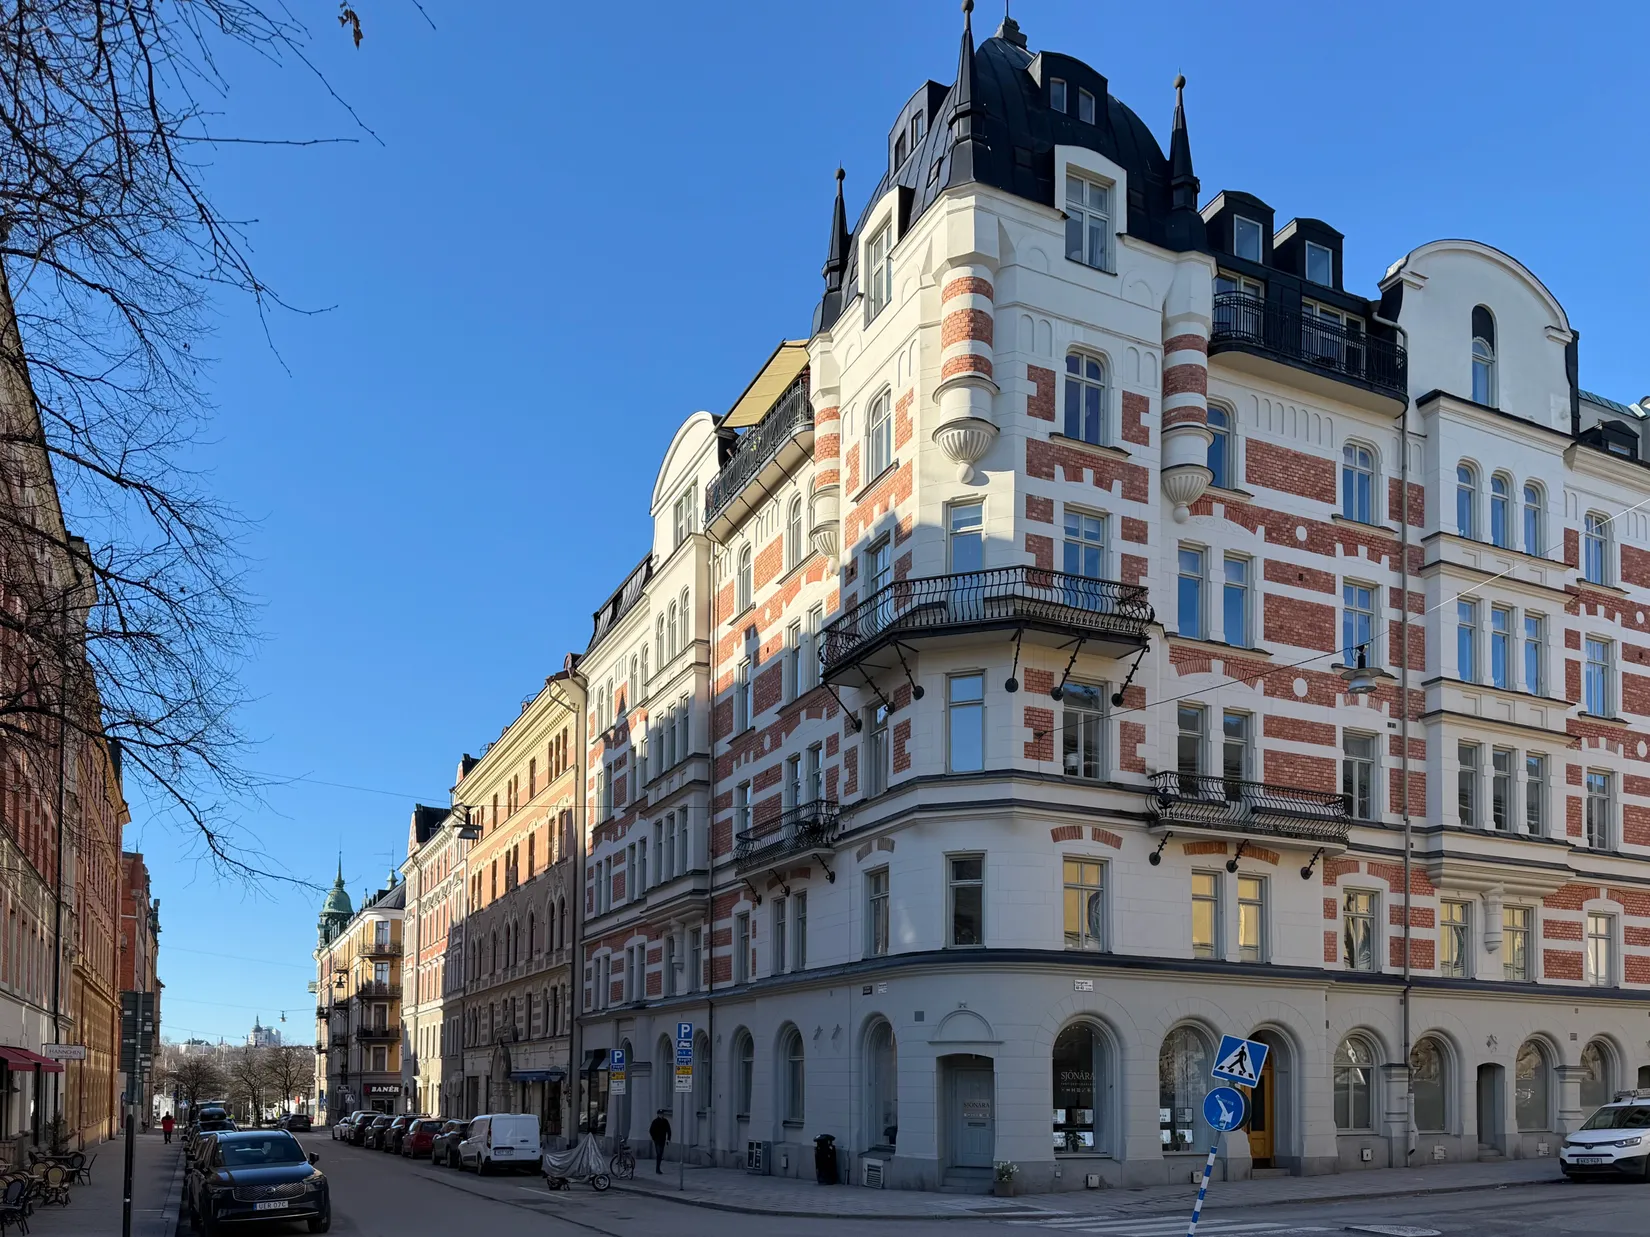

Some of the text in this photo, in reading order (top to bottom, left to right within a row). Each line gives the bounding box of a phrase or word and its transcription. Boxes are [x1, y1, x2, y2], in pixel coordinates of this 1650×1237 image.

[681, 1024, 690, 1038] P
[614, 1050, 623, 1063] P
[371, 1085, 399, 1093] BANÉR
